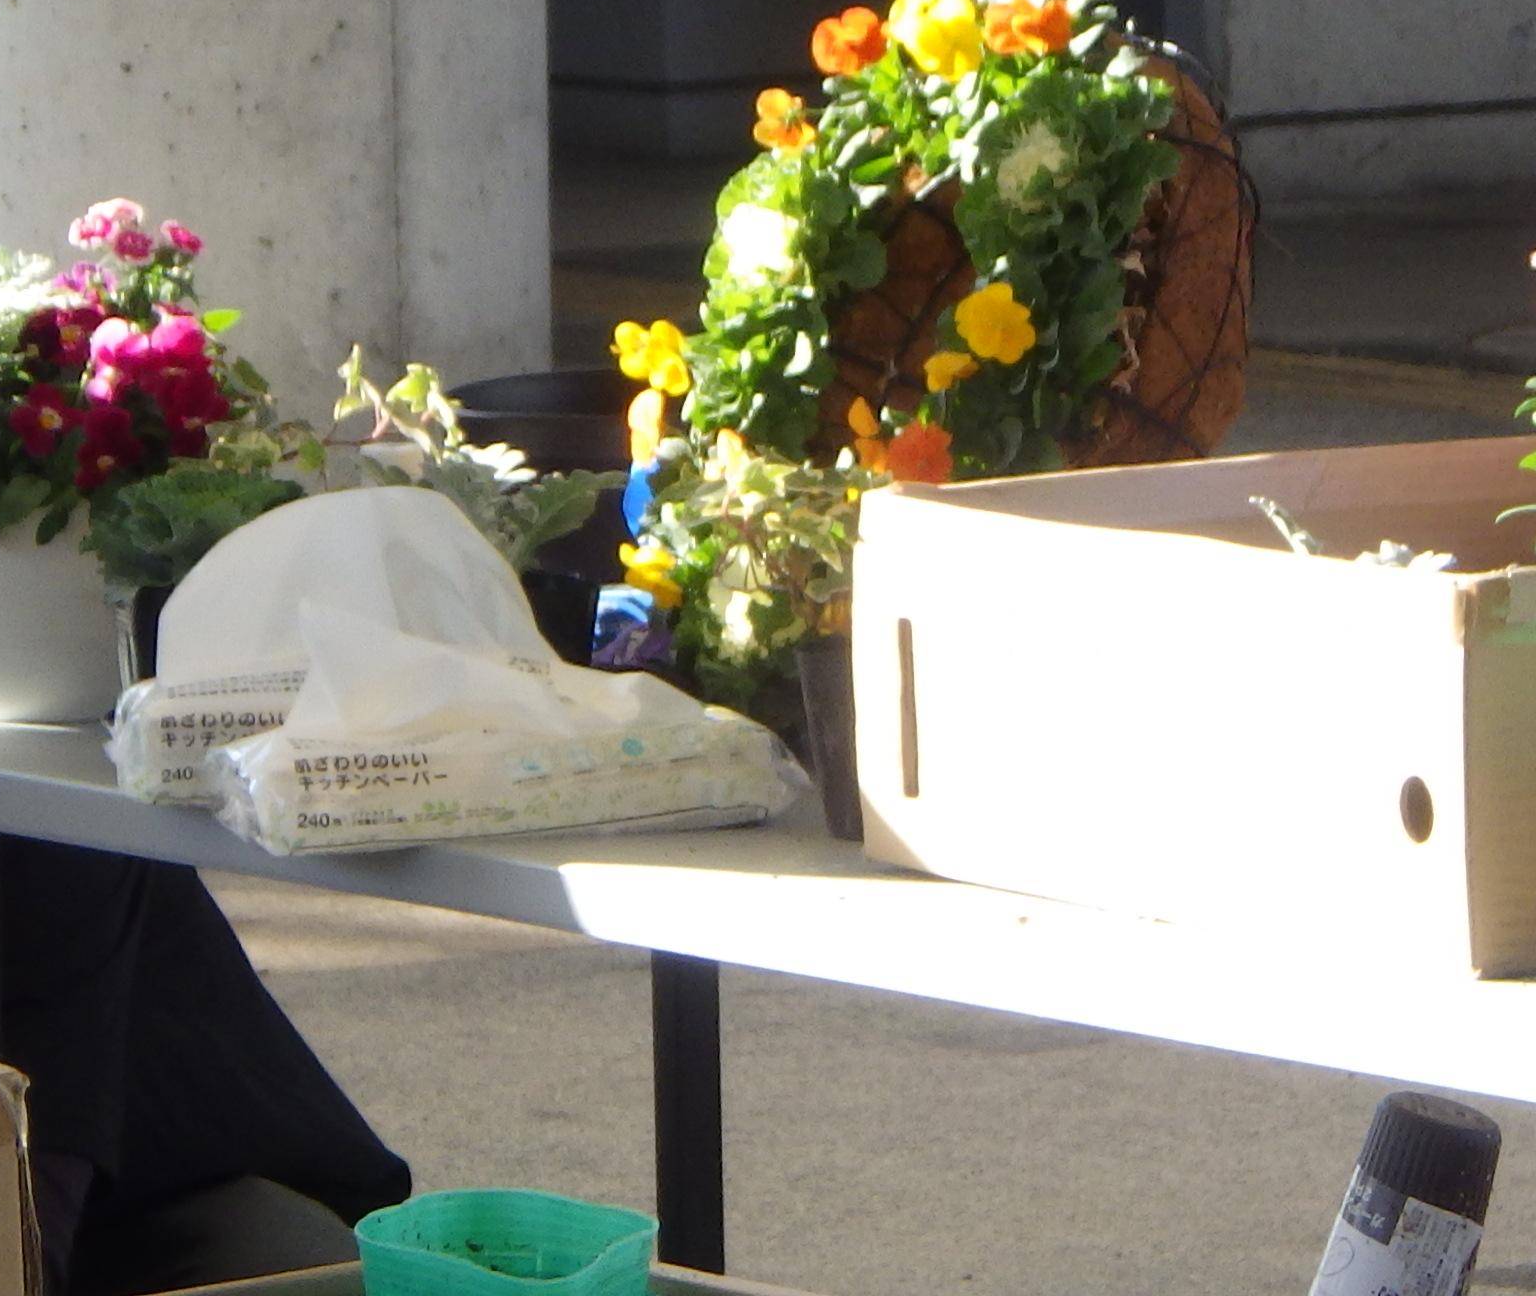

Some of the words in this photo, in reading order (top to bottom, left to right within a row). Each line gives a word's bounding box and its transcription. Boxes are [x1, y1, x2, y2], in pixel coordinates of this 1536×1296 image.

[298, 772, 448, 792] キッチンペーパー
